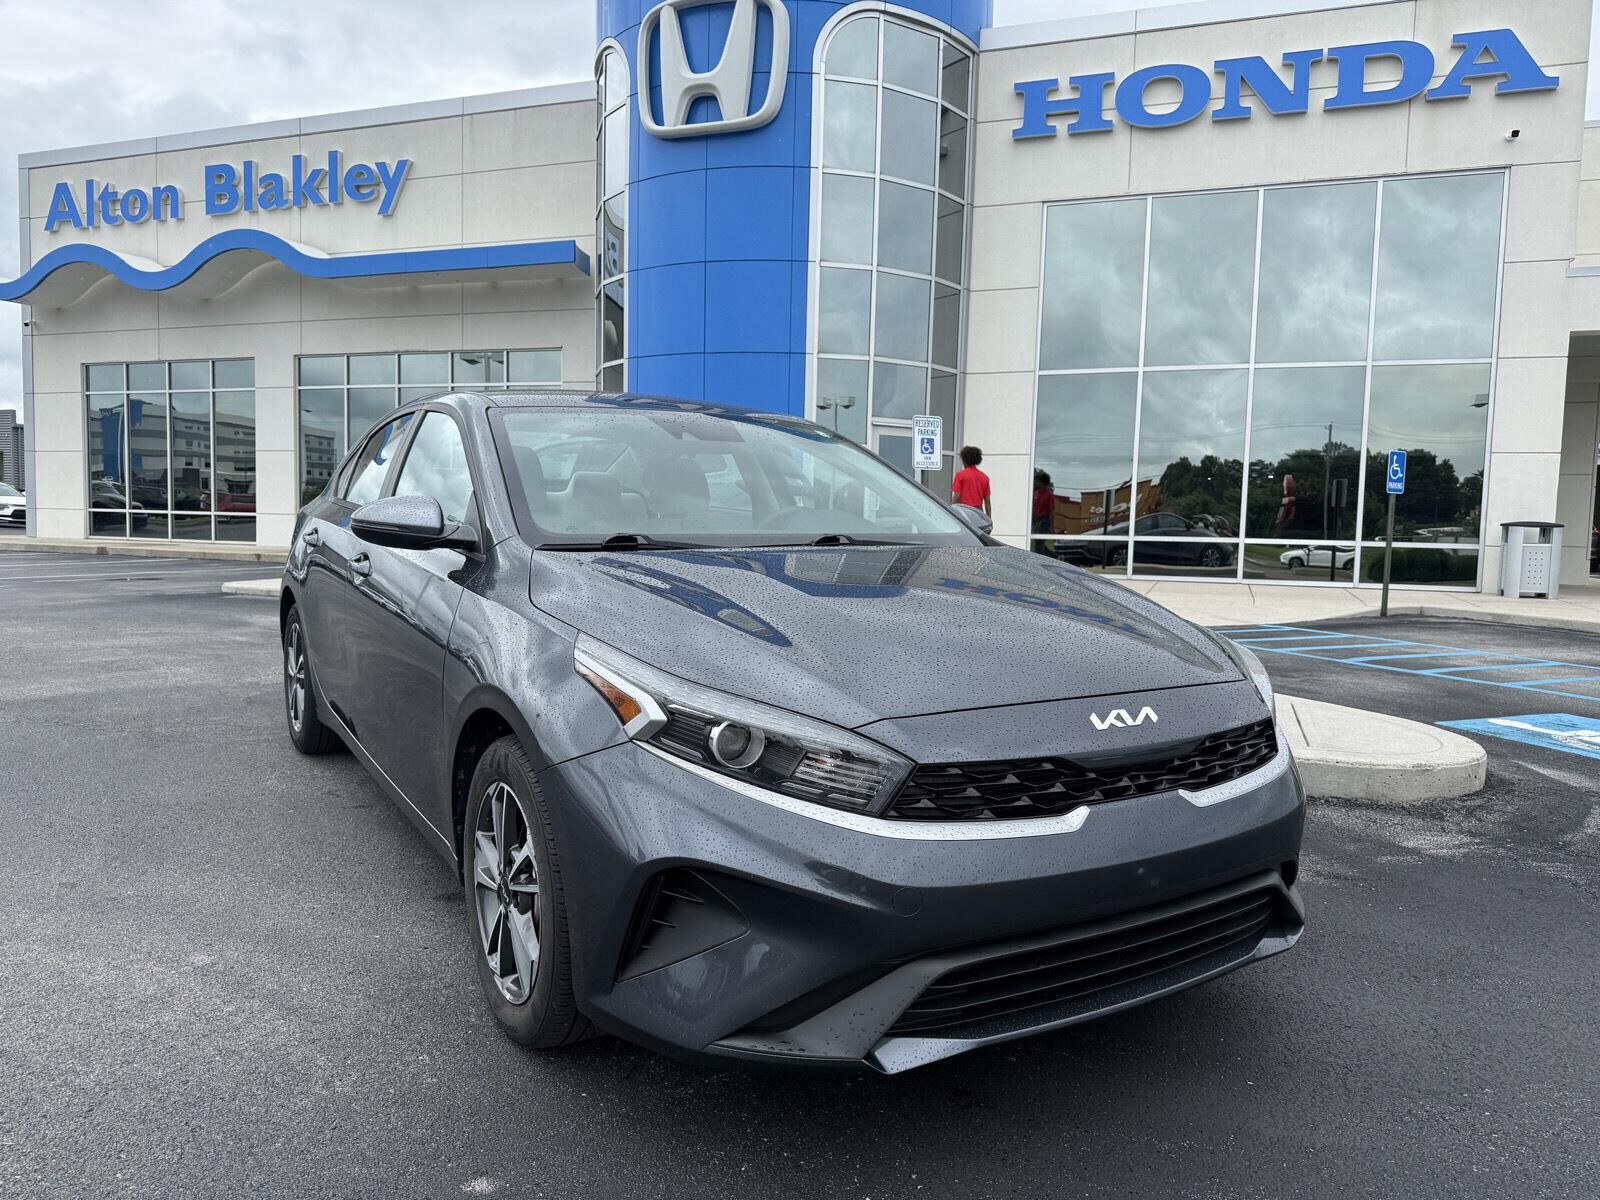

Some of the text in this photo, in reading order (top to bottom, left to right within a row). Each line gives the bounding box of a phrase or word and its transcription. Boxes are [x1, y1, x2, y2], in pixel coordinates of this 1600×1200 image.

[1012, 28, 1560, 141] HONDA
[44, 150, 413, 232] Alton Blakley
[915, 419, 940, 428] RESERVED
[917, 428, 937, 437] PARKING
[1388, 481, 1403, 489] PARKING
[1089, 706, 1159, 731] KIA
